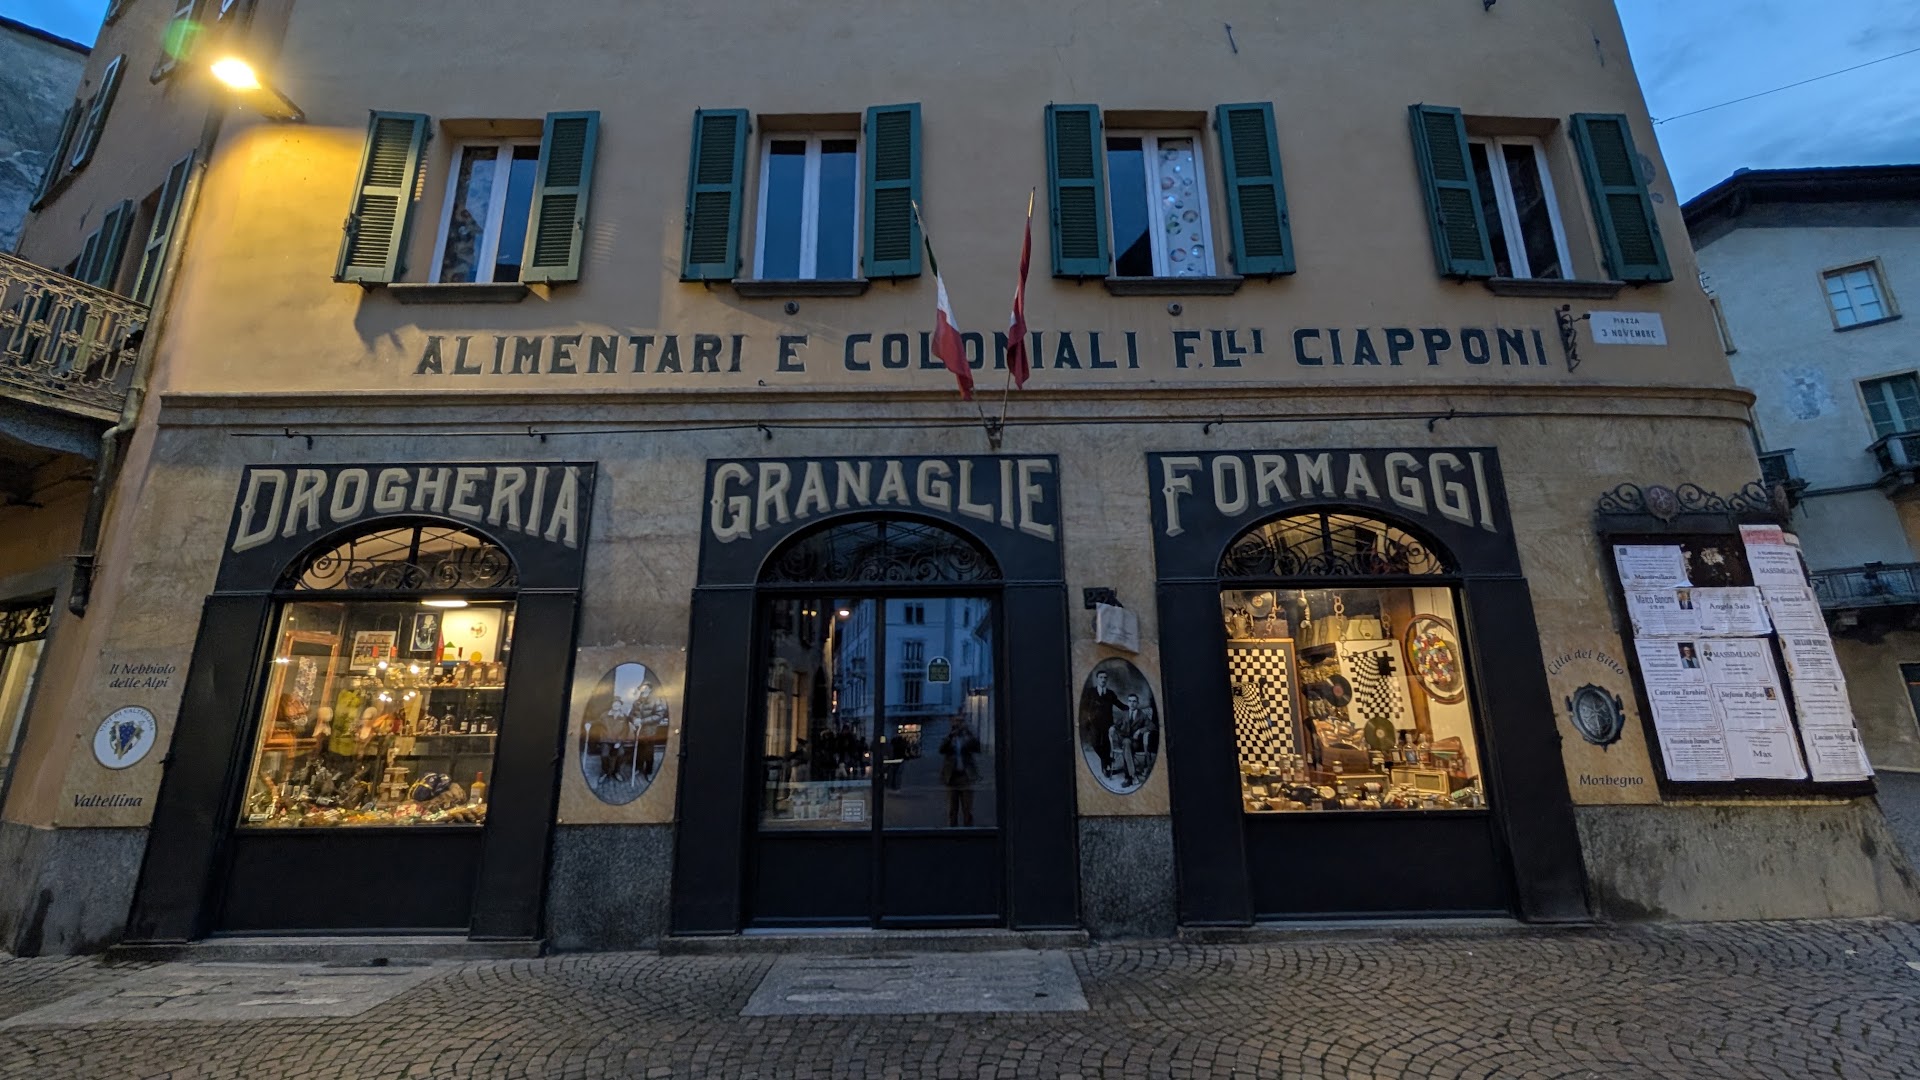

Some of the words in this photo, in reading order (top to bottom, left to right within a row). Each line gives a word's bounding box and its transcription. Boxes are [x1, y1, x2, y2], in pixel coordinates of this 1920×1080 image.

[1602, 329, 1608, 337] 3
[1611, 329, 1656, 338] NOVEMBRE
[414, 333, 745, 375] ALIMENTARI
[776, 334, 810, 373] E
[1293, 328, 1549, 367] CIAPPONI
[709, 458, 1056, 543] GRANAGLIE
[1159, 451, 1498, 538] FORMAGGI
[231, 466, 581, 554] DROGHERIA
[1712, 650, 1761, 658] MASSIMILIANO
[110, 663, 120, 675] Il
[121, 663, 176, 675] Nebbiolo
[1548, 652, 1572, 676] Città
[1574, 649, 1592, 660] del
[1596, 651, 1625, 676] Bitto
[109, 677, 142, 689] delle
[142, 676, 169, 690] Alpi
[1752, 750, 1773, 758] Max
[1579, 774, 1644, 788] Morbegno
[74, 793, 143, 808] Valtellina
